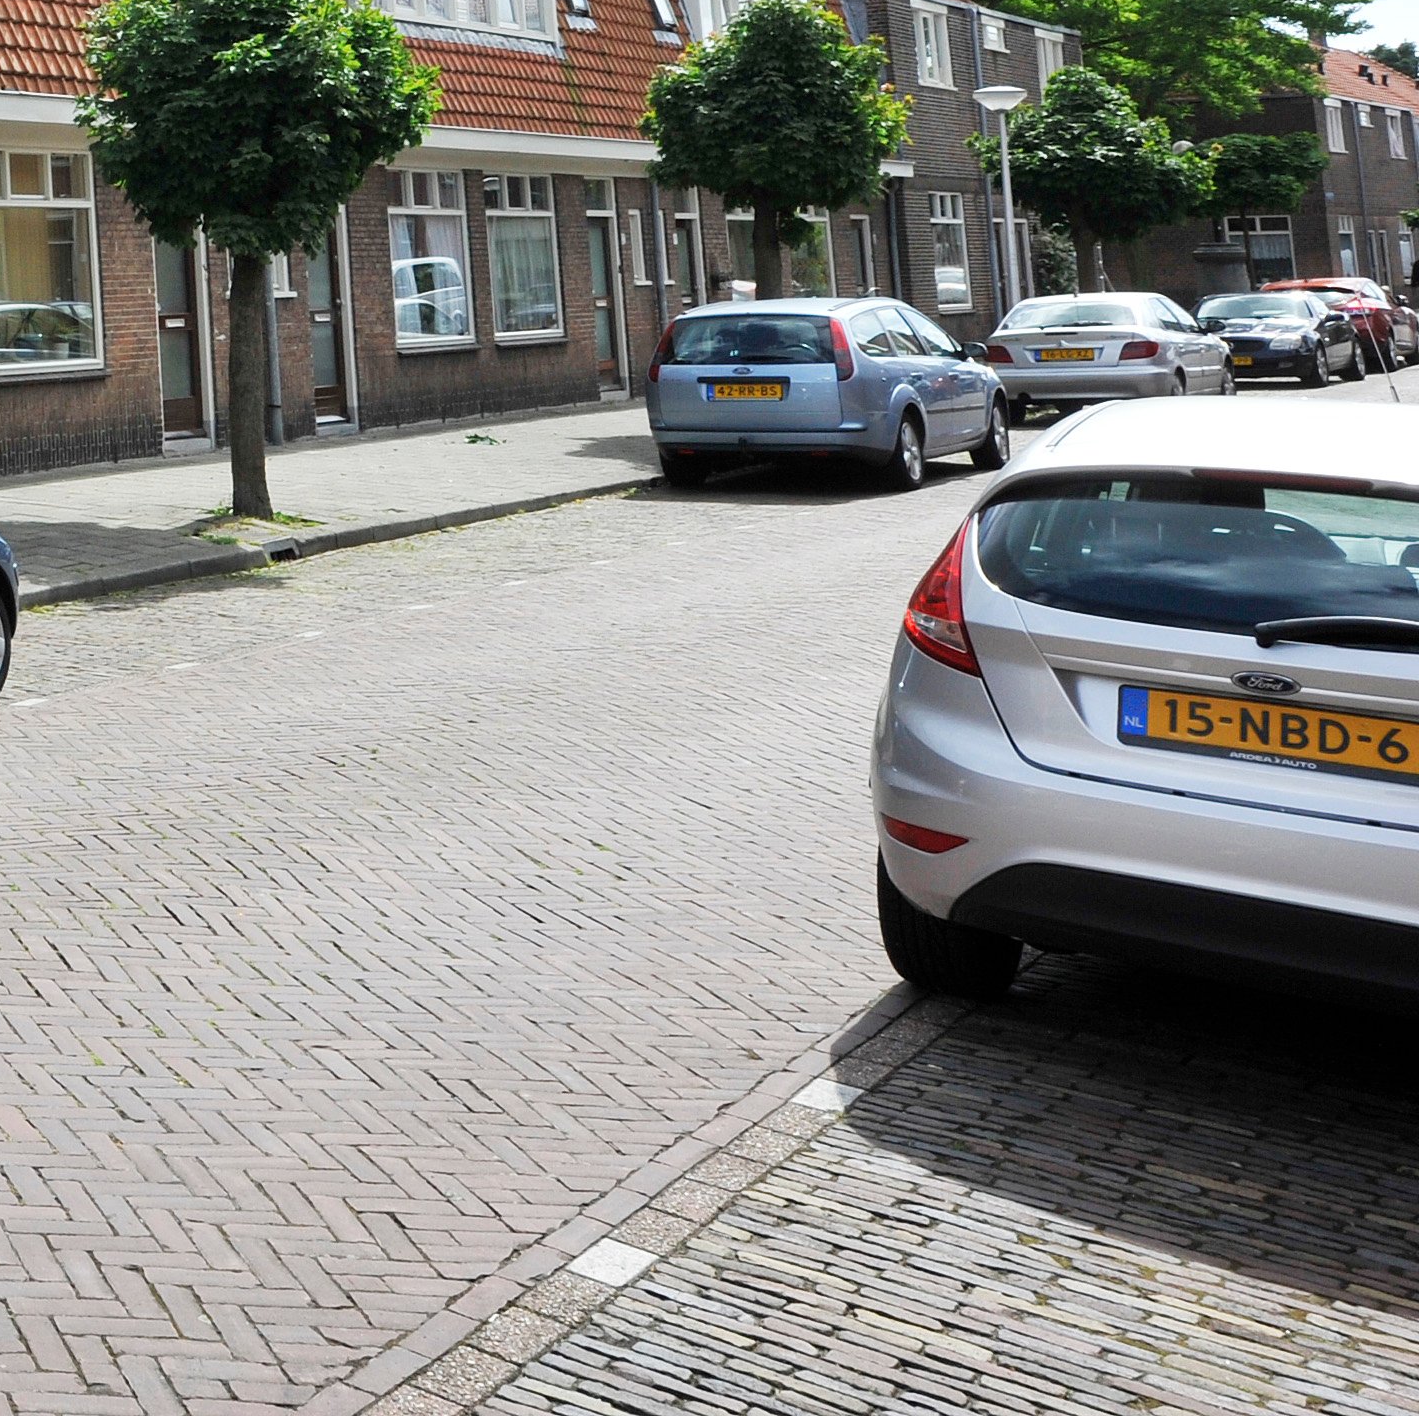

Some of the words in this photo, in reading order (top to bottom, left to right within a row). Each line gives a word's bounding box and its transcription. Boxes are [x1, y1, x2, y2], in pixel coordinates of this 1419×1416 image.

[717, 385, 778, 396] 42-RR-BS
[1247, 676, 1284, 691] Ford
[1124, 715, 1144, 728] NL
[1164, 698, 1410, 765] 15-NBD-6
[1229, 751, 1272, 763] ARDEA
[1281, 758, 1318, 770] AUTO
